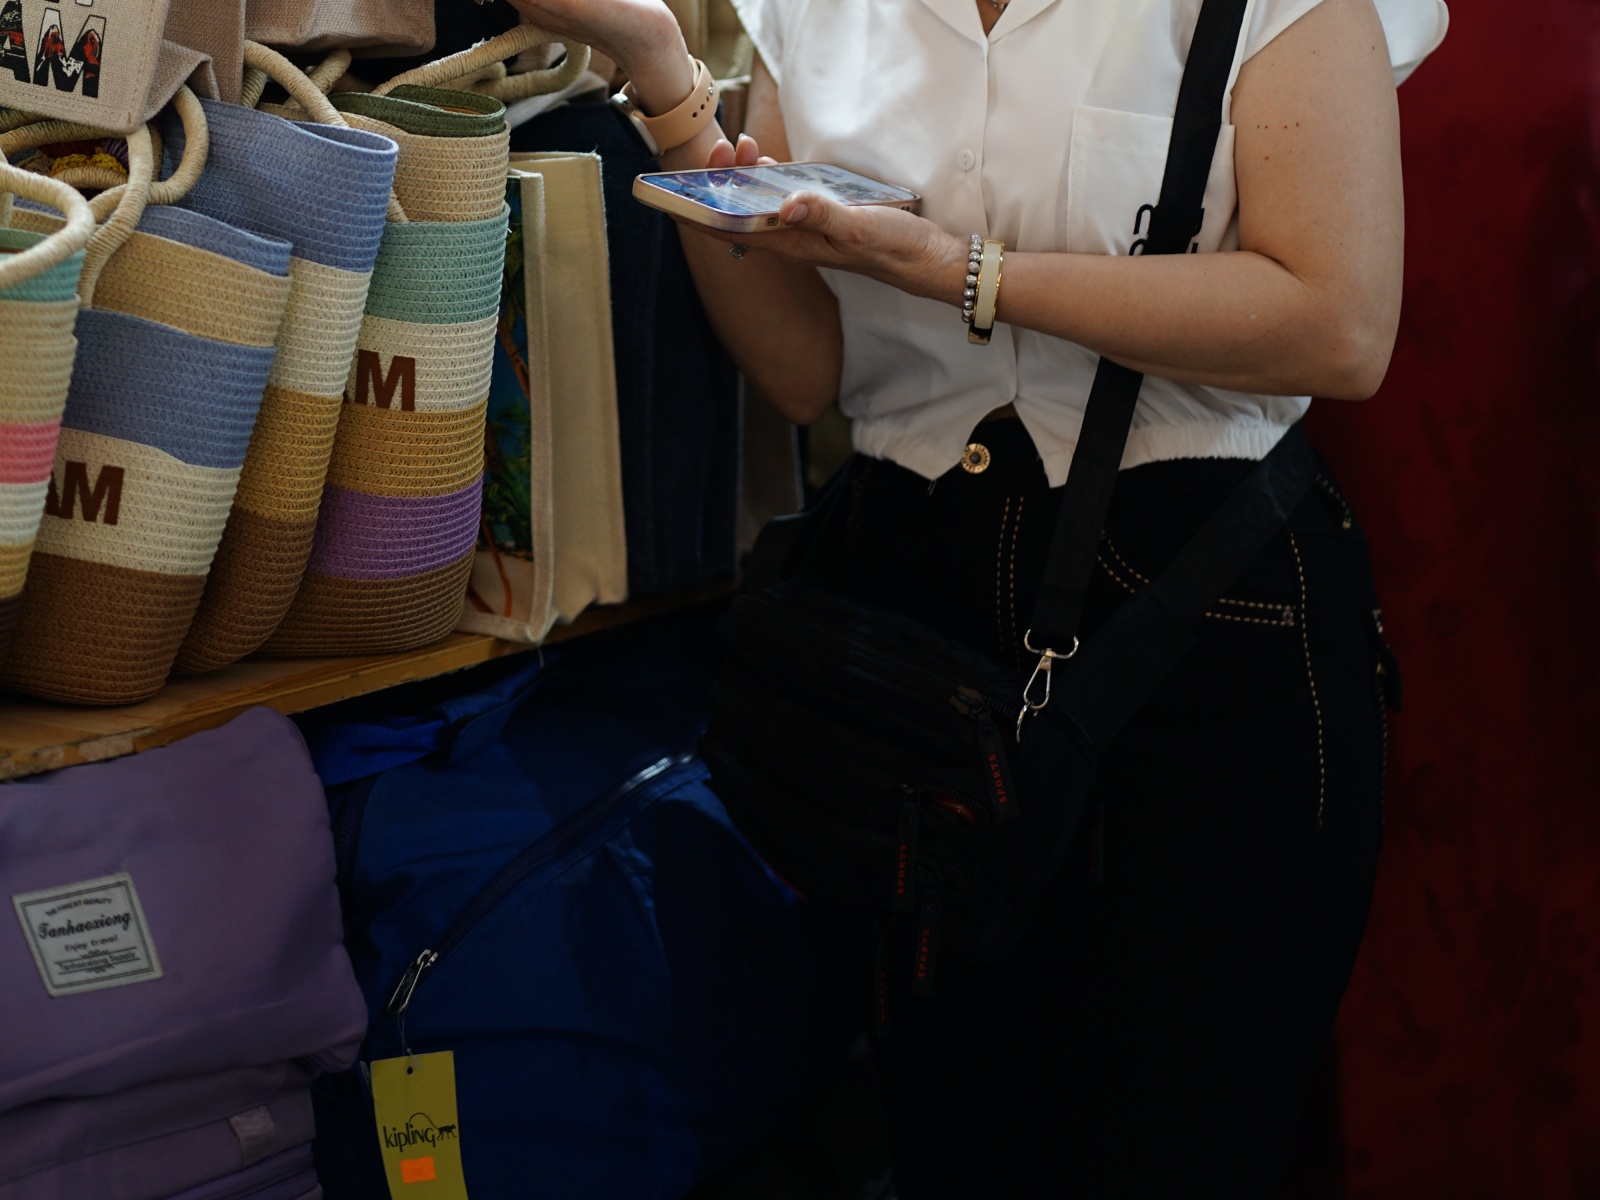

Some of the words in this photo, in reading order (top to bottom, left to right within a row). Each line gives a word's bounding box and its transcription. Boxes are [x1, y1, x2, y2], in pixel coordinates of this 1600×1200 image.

[343, 349, 415, 412] M
[988, 753, 1007, 804] SPORTS
[897, 843, 909, 896] SPORTS
[83, 897, 112, 906] QUALITY
[64, 942, 87, 952] Enjoy
[90, 935, 118, 947] travel
[917, 928, 931, 980] SPORTS
